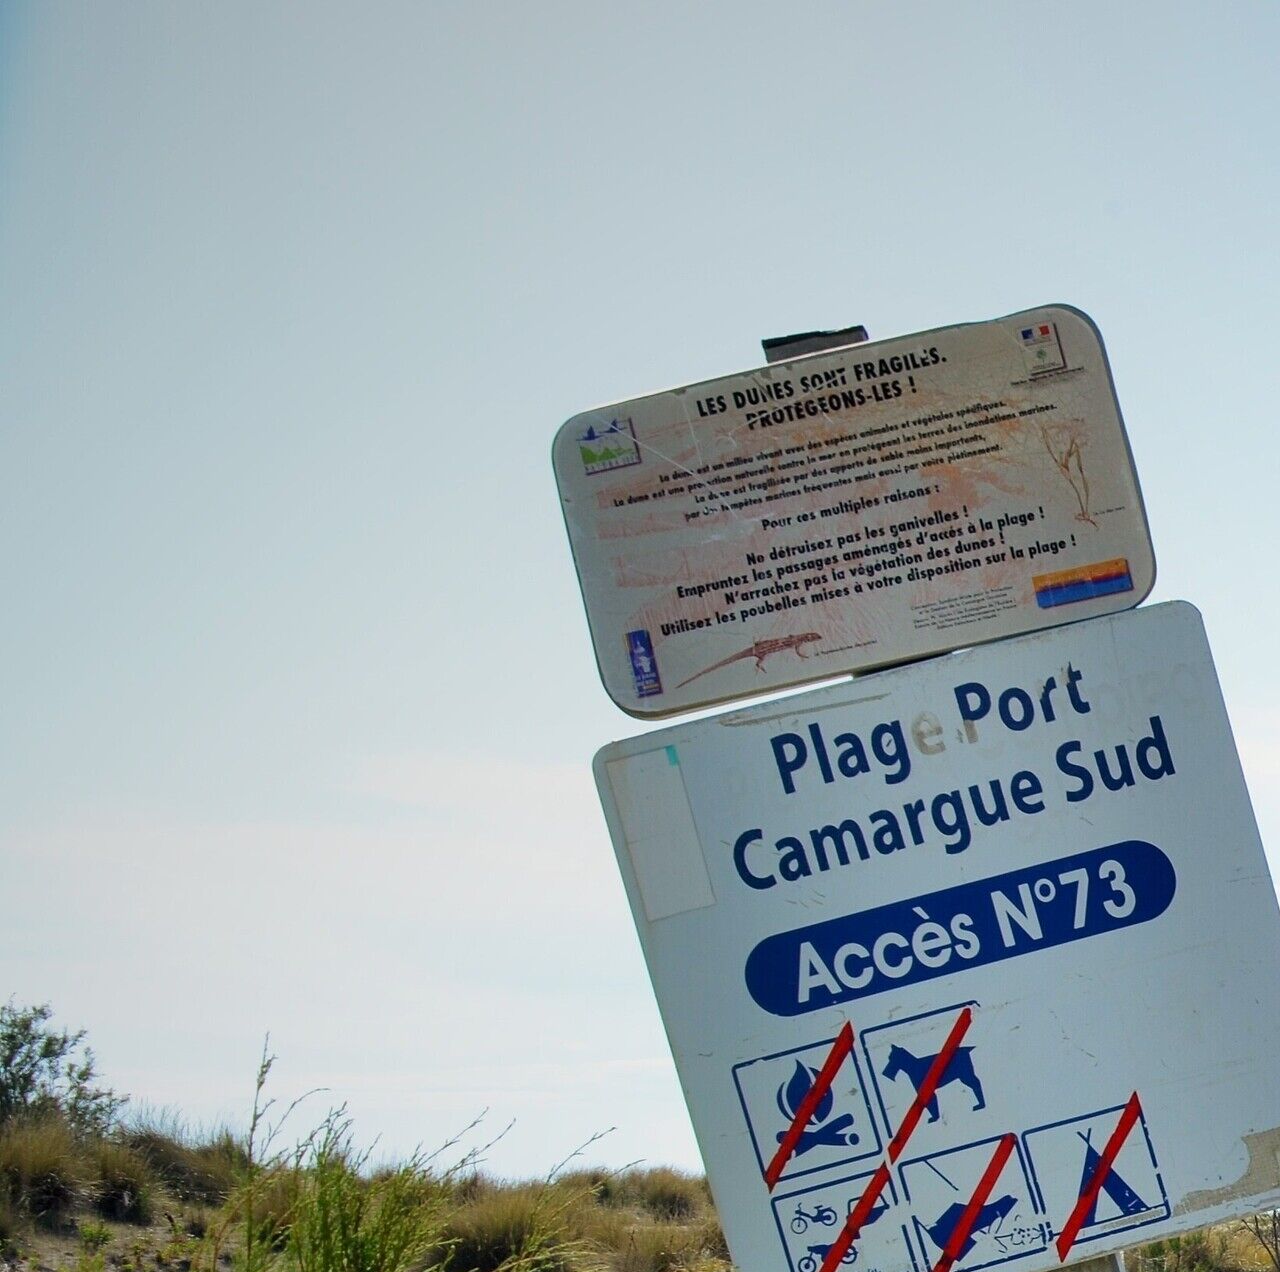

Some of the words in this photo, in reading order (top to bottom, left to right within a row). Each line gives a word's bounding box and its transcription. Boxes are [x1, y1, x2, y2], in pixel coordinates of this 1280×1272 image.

[696, 395, 727, 417] LES
[732, 380, 794, 409] DUNES
[800, 367, 847, 393] SONT
[627, 494, 649, 504] dune
[652, 489, 666, 499] est
[668, 487, 685, 495] une
[687, 476, 733, 493] proction
[735, 465, 775, 480] naturelle
[777, 460, 805, 470] contre
[902, 434, 916, 443] les
[918, 429, 945, 439] terres
[947, 424, 963, 433] des
[964, 413, 1017, 429] inondations
[672, 470, 694, 480] dun
[697, 465, 710, 474] est
[726, 457, 753, 468] milieu
[756, 449, 783, 461] vivant
[785, 446, 805, 455] avec
[807, 441, 822, 450] des
[859, 424, 899, 438] animales
[901, 421, 910, 429] et
[733, 486, 746, 495] est
[794, 473, 808, 484] par
[811, 469, 827, 477] des
[867, 457, 877, 465] de
[880, 451, 904, 462] sable
[685, 511, 700, 522] par
[765, 489, 801, 502] marines
[855, 473, 876, 482] mais
[904, 463, 919, 474] par
[761, 517, 792, 531] Pour
[797, 512, 816, 523] ces
[820, 497, 880, 518] multiples
[884, 487, 931, 504] raisons
[677, 575, 749, 598] Empruntez
[752, 569, 773, 582] les
[777, 555, 839, 580] passages
[968, 522, 976, 534] à
[979, 518, 993, 531] la
[997, 513, 1035, 536] plage
[725, 577, 800, 605] N'arrachez
[804, 568, 828, 591] pas
[832, 568, 845, 581] la
[927, 547, 950, 560] des
[955, 538, 995, 554] dunes
[746, 553, 765, 566] Ne
[769, 539, 833, 560] détruisez
[837, 533, 861, 549] pas
[865, 527, 885, 539] les
[890, 510, 959, 537] ganivelles
[661, 618, 712, 636] Utilisez
[715, 611, 736, 624] les
[740, 595, 807, 623] poubelles
[811, 587, 850, 603] mises
[854, 584, 863, 593] à
[867, 574, 902, 590] votre
[907, 558, 981, 582] disposition
[985, 553, 1006, 565] sur
[1010, 546, 1024, 560] la
[1028, 540, 1066, 559] plage
[770, 712, 946, 794] Plage
[955, 662, 1091, 744] Port
[733, 771, 1045, 890] Camargue
[1056, 715, 1176, 802] Sud
[797, 908, 981, 1003] Accès
[993, 860, 1136, 947] N°73
